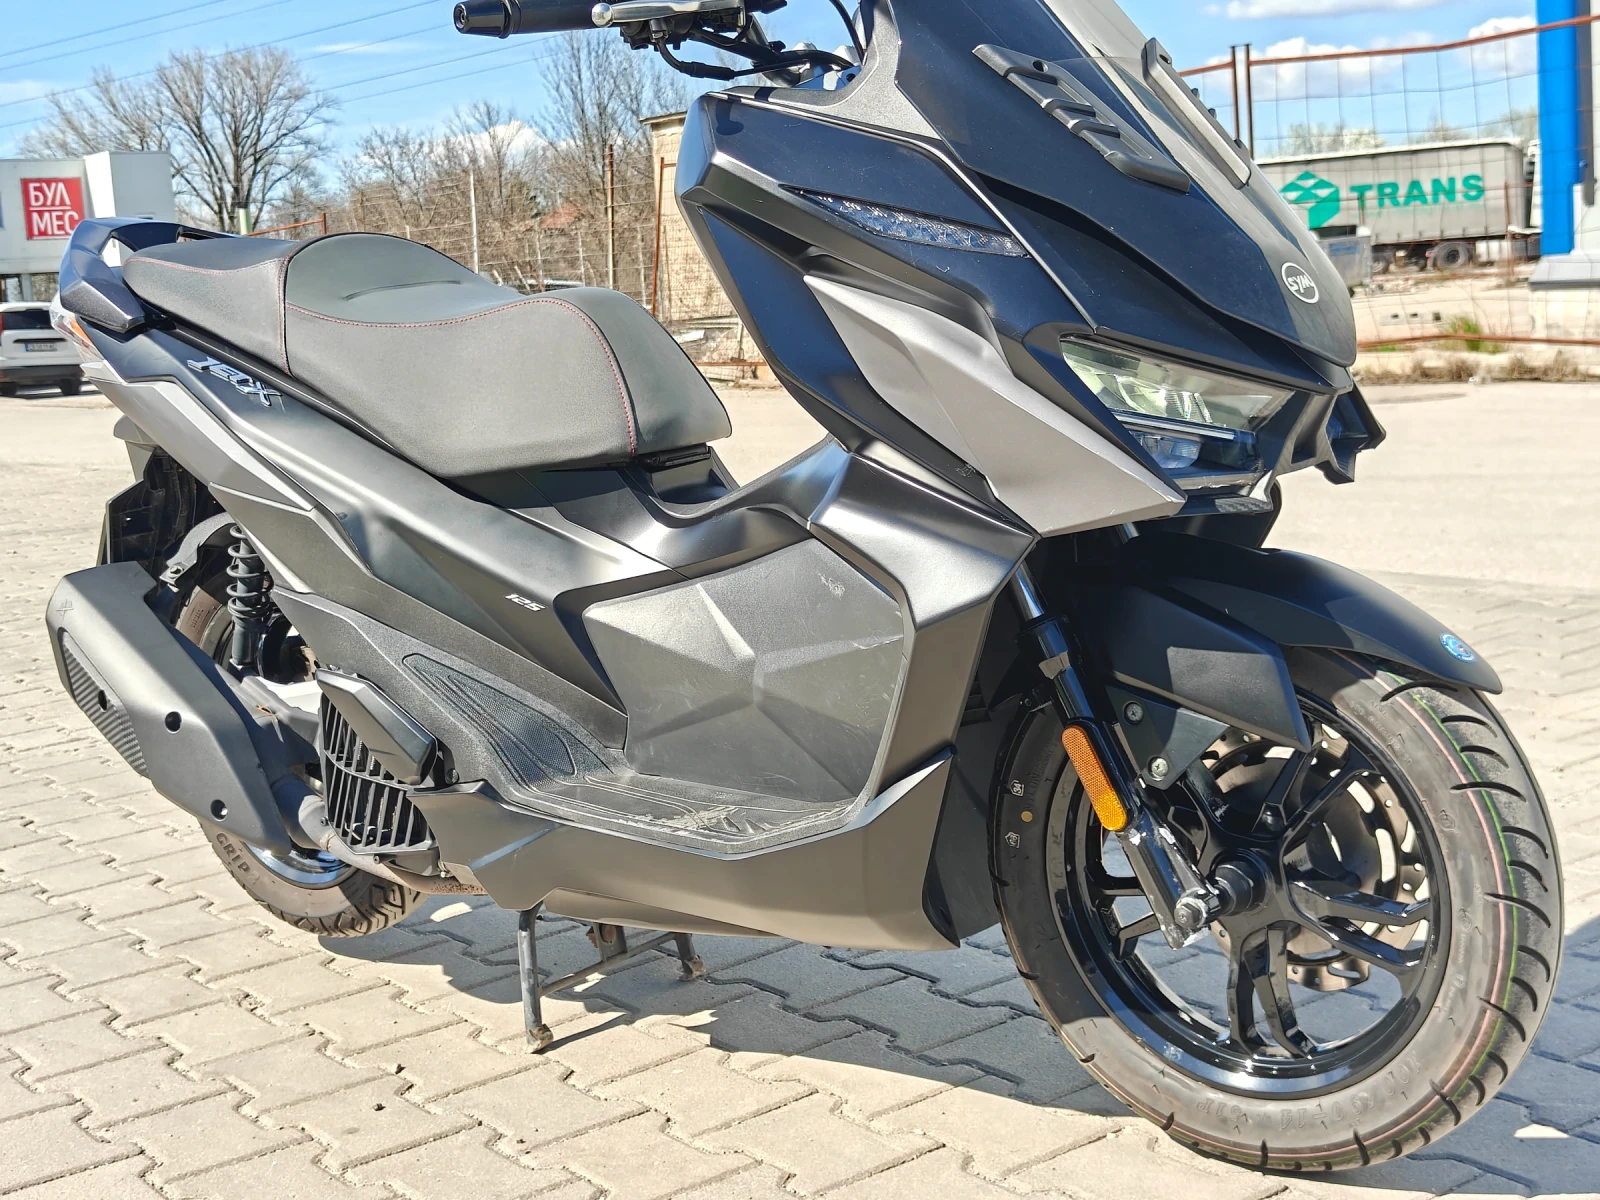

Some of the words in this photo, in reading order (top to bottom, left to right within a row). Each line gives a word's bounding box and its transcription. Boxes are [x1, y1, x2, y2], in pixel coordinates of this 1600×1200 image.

[28, 182, 71, 207] БУЛ
[1350, 174, 1485, 209] TRANS
[1287, 274, 1315, 294] SYM
[504, 593, 547, 612] 125
[215, 832, 250, 873] GRIP
